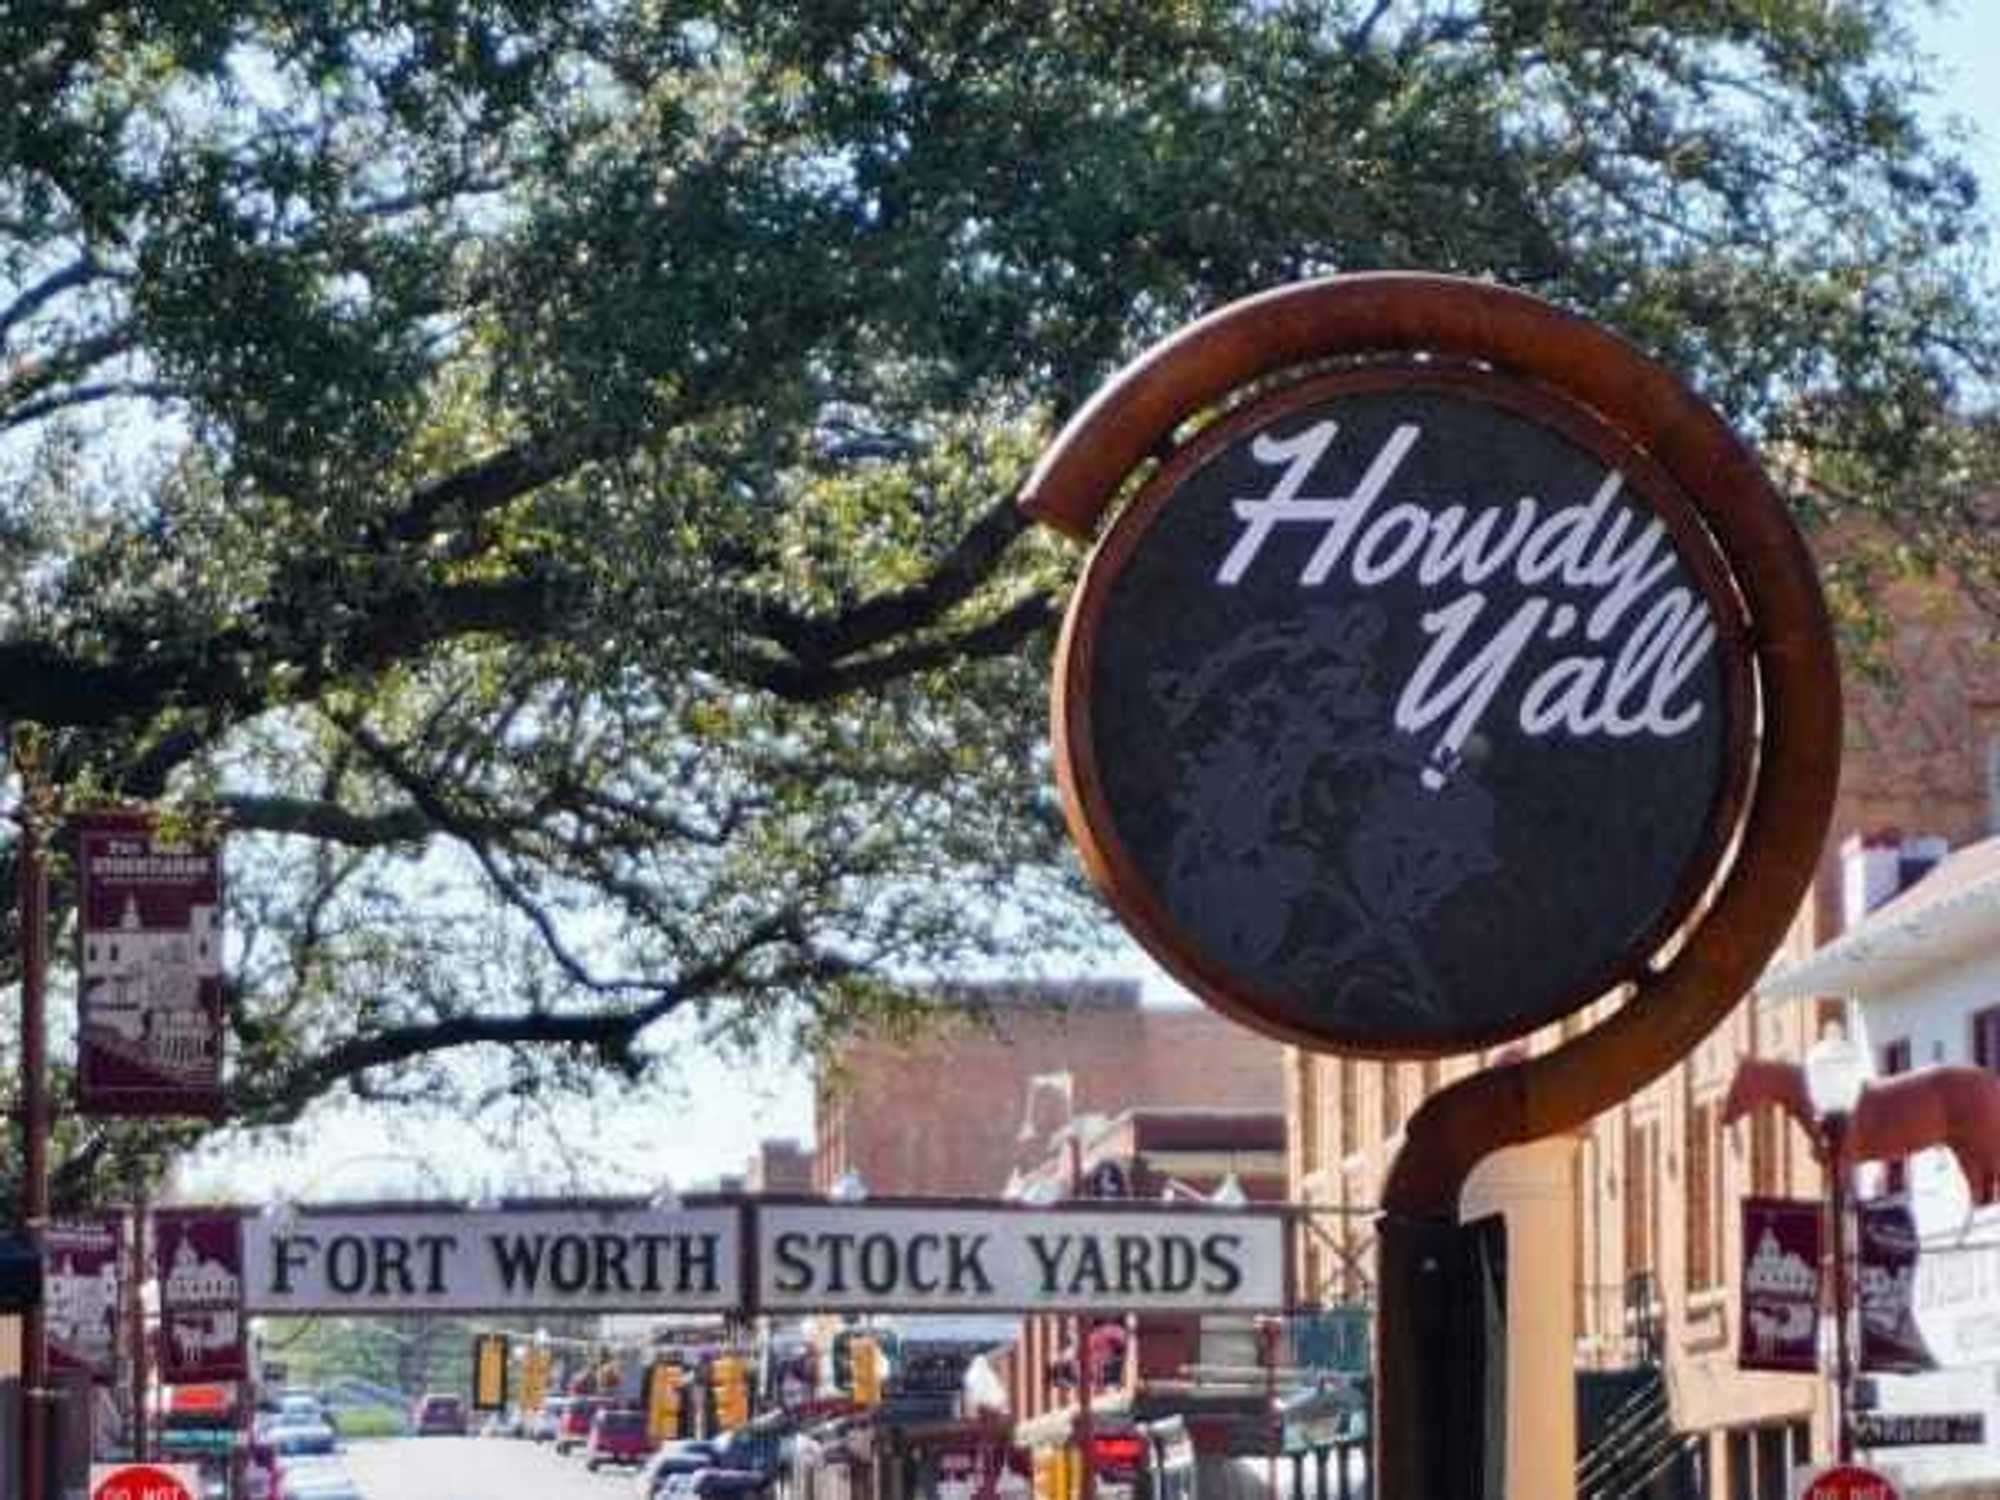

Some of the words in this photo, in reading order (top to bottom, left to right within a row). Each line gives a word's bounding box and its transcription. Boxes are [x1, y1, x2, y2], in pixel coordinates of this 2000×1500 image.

[1216, 420, 1677, 640] Howdy
[1395, 587, 1716, 790] Y'all
[268, 1233, 458, 1295] FORT
[488, 1233, 722, 1294] WORTH
[773, 1232, 994, 1294] STOCK
[1026, 1233, 1242, 1295] YARDS
